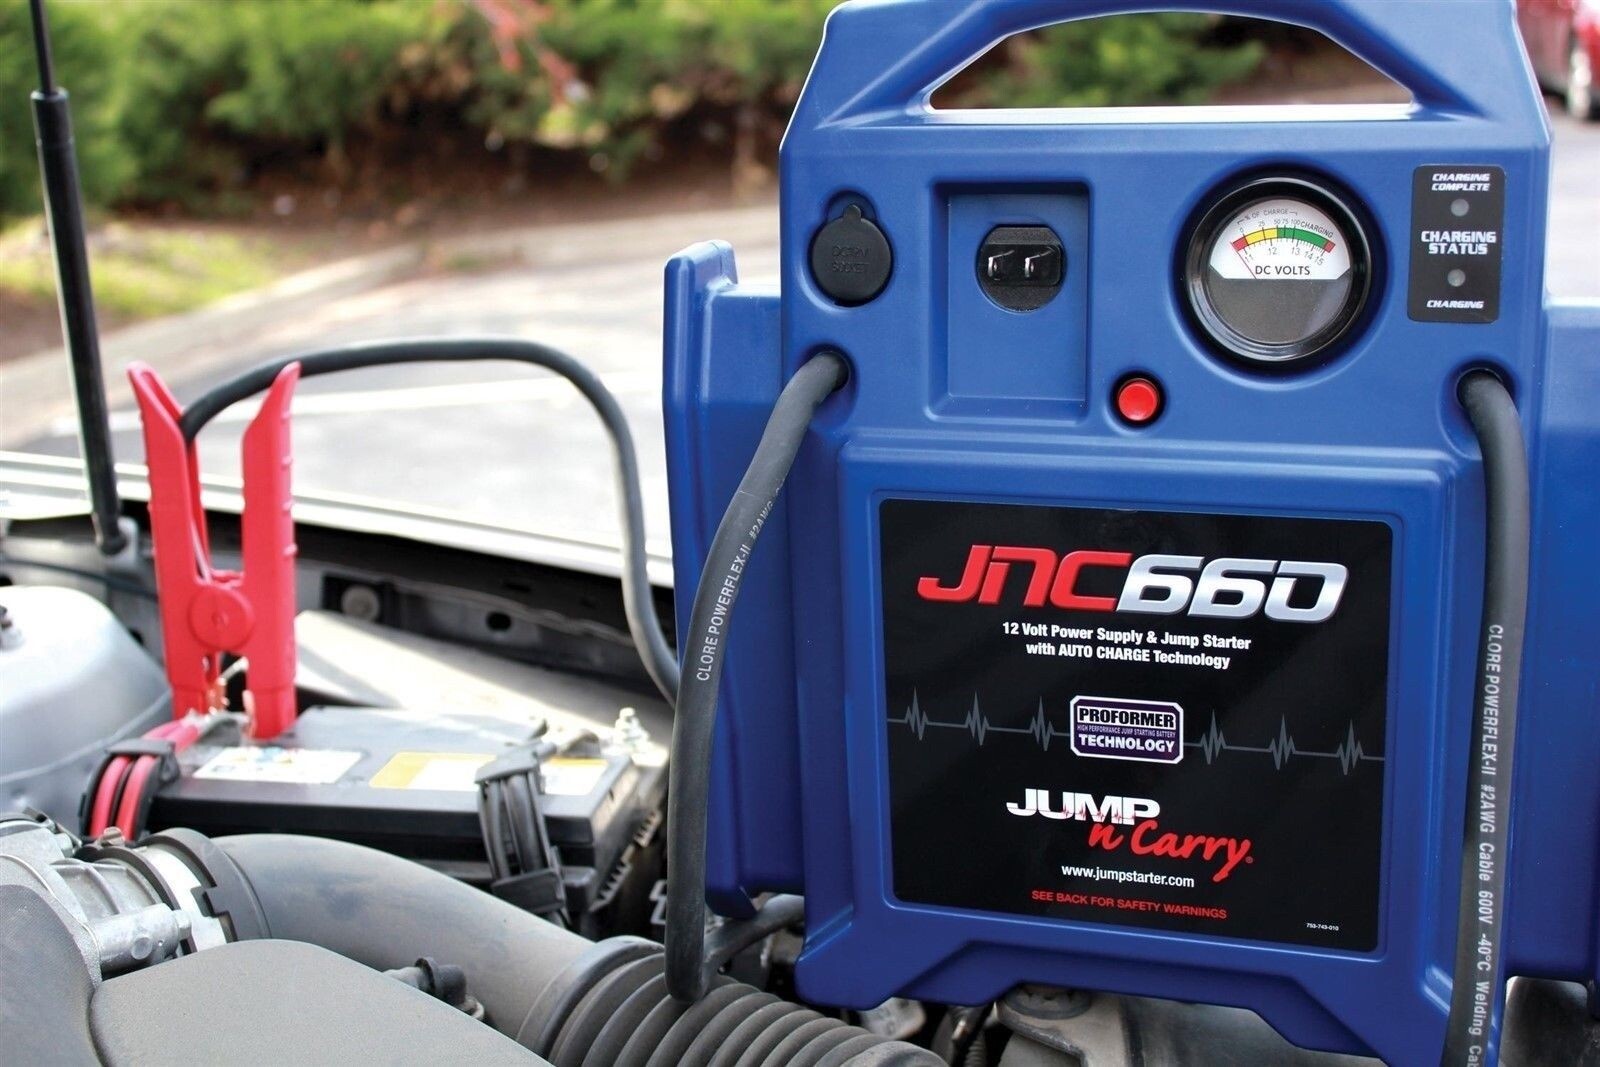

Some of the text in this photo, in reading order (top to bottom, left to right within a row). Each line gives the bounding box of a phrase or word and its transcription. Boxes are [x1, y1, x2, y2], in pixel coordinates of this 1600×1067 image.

[1431, 183, 1490, 191] COMPLETE
[1432, 173, 1490, 182] CHARGING
[1263, 208, 1288, 216] CHARGE
[1300, 221, 1334, 238] CHARGING
[1421, 230, 1497, 243] CHARGING
[1268, 247, 1277, 256] 12
[1291, 247, 1300, 256] 13
[1304, 251, 1314, 260] 14
[1315, 256, 1325, 266] 15
[1428, 242, 1488, 255] STATUS
[1255, 266, 1310, 275] DC VOLTS
[1426, 300, 1484, 309] CHARGING
[1002, 622, 1251, 650] 12 Volt Power Supply & Jump Starter
[697, 636, 719, 681] CLORE
[1026, 642, 1230, 670] with AUTO CHARGE Technology
[1486, 624, 1504, 672] CLORE
[1079, 707, 1174, 728] PROFORMER
[1078, 733, 1175, 753] TECHNOLOGY
[1089, 726, 1120, 734] PERFORMANCE
[1156, 730, 1176, 738] BATTERY
[1006, 788, 1160, 825] JUMP
[1479, 784, 1496, 833] #2AWG
[1088, 822, 1124, 850] n
[1478, 842, 1495, 881] Cable
[1061, 865, 1195, 888] www.jumpstarter.com
[1031, 890, 1227, 919] SEE BACK FOR SAFETY WARNINGS
[1478, 890, 1493, 925] 600V
[1468, 981, 1490, 1036] Welding
